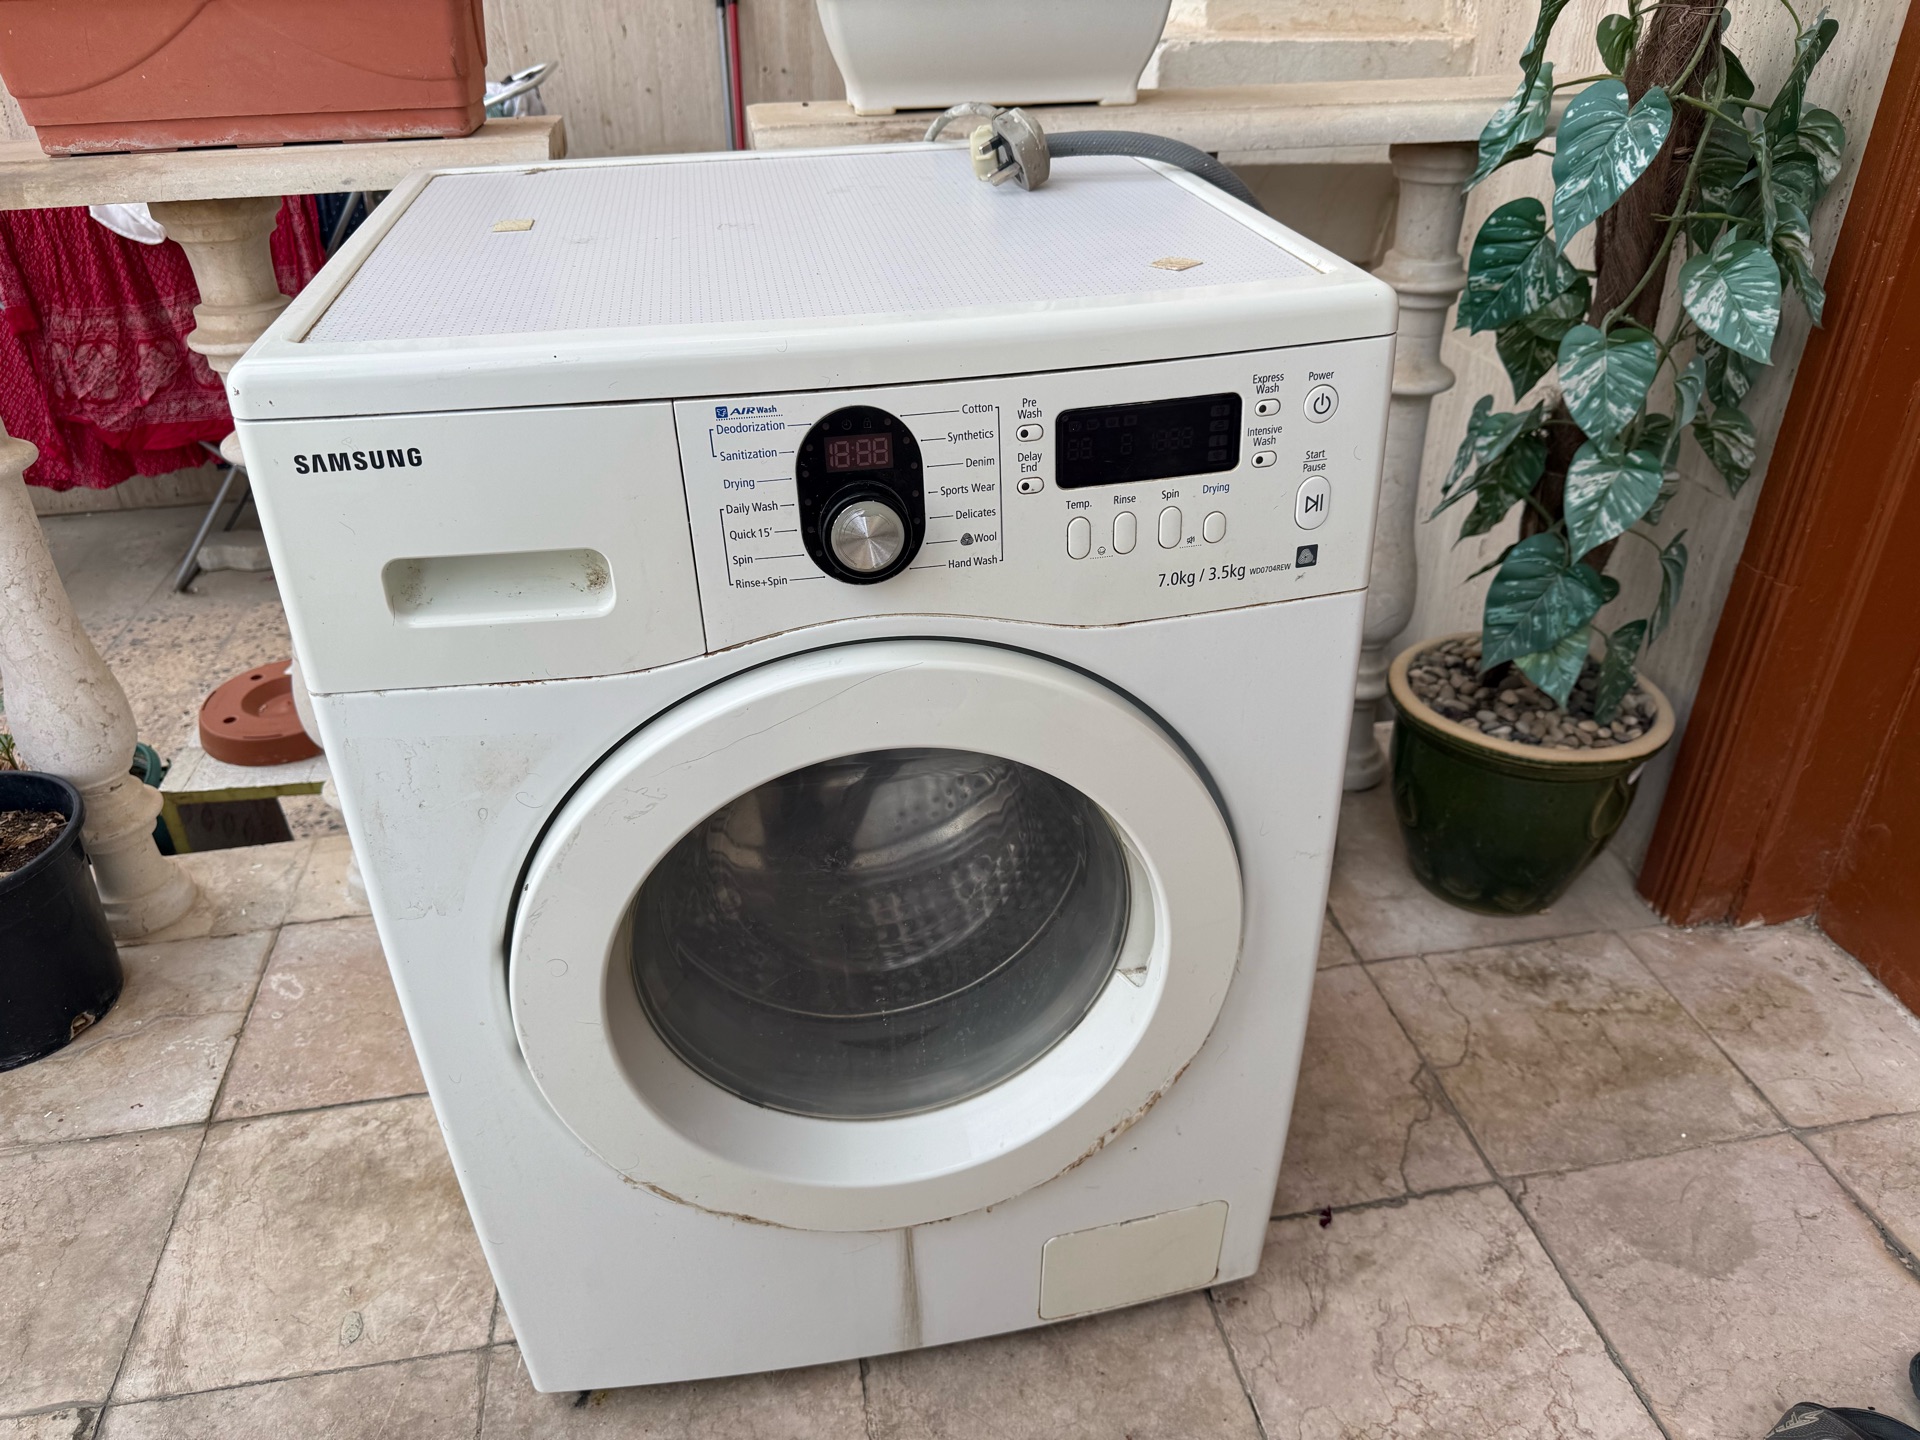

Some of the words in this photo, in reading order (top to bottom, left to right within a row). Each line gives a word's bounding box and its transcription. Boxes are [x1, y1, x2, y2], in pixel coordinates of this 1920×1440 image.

[1252, 374, 1284, 385] Express
[1308, 371, 1334, 381] Power
[1256, 383, 1279, 394] Wash
[961, 403, 993, 415] Cotton
[1022, 398, 1037, 408] Pre
[1017, 408, 1042, 419] Wash
[716, 421, 786, 435] Deodorization
[1247, 425, 1283, 437] Intensive
[947, 428, 994, 443] Synthetics
[1253, 435, 1276, 446] Wash
[720, 448, 778, 461] Sanitization
[1017, 451, 1043, 464] Delay
[1305, 450, 1326, 460] Start
[293, 447, 423, 475] SAMSUNG
[965, 457, 995, 468] Denim
[1020, 463, 1037, 473] End
[1302, 462, 1327, 473] Pause
[723, 478, 756, 491] Drying
[940, 485, 969, 497] Sports
[971, 483, 995, 493] Wear
[1202, 483, 1230, 495] Drying
[1113, 494, 1137, 505] Rinse
[1161, 488, 1180, 500] Spin
[726, 503, 750, 516] Daily
[751, 501, 779, 513] Wash
[1066, 500, 1093, 510] Temp.
[955, 508, 997, 520] Delicates
[729, 529, 757, 541] Quick
[974, 532, 997, 543] Wool
[732, 555, 754, 567] Spin
[948, 557, 972, 569] Hand
[973, 554, 998, 566] Wash
[1158, 570, 1196, 587] 7.0kg
[1208, 564, 1246, 580] 3.5kg
[1249, 563, 1292, 575] WD0704REW
[735, 577, 788, 589] Rinse+Spin
